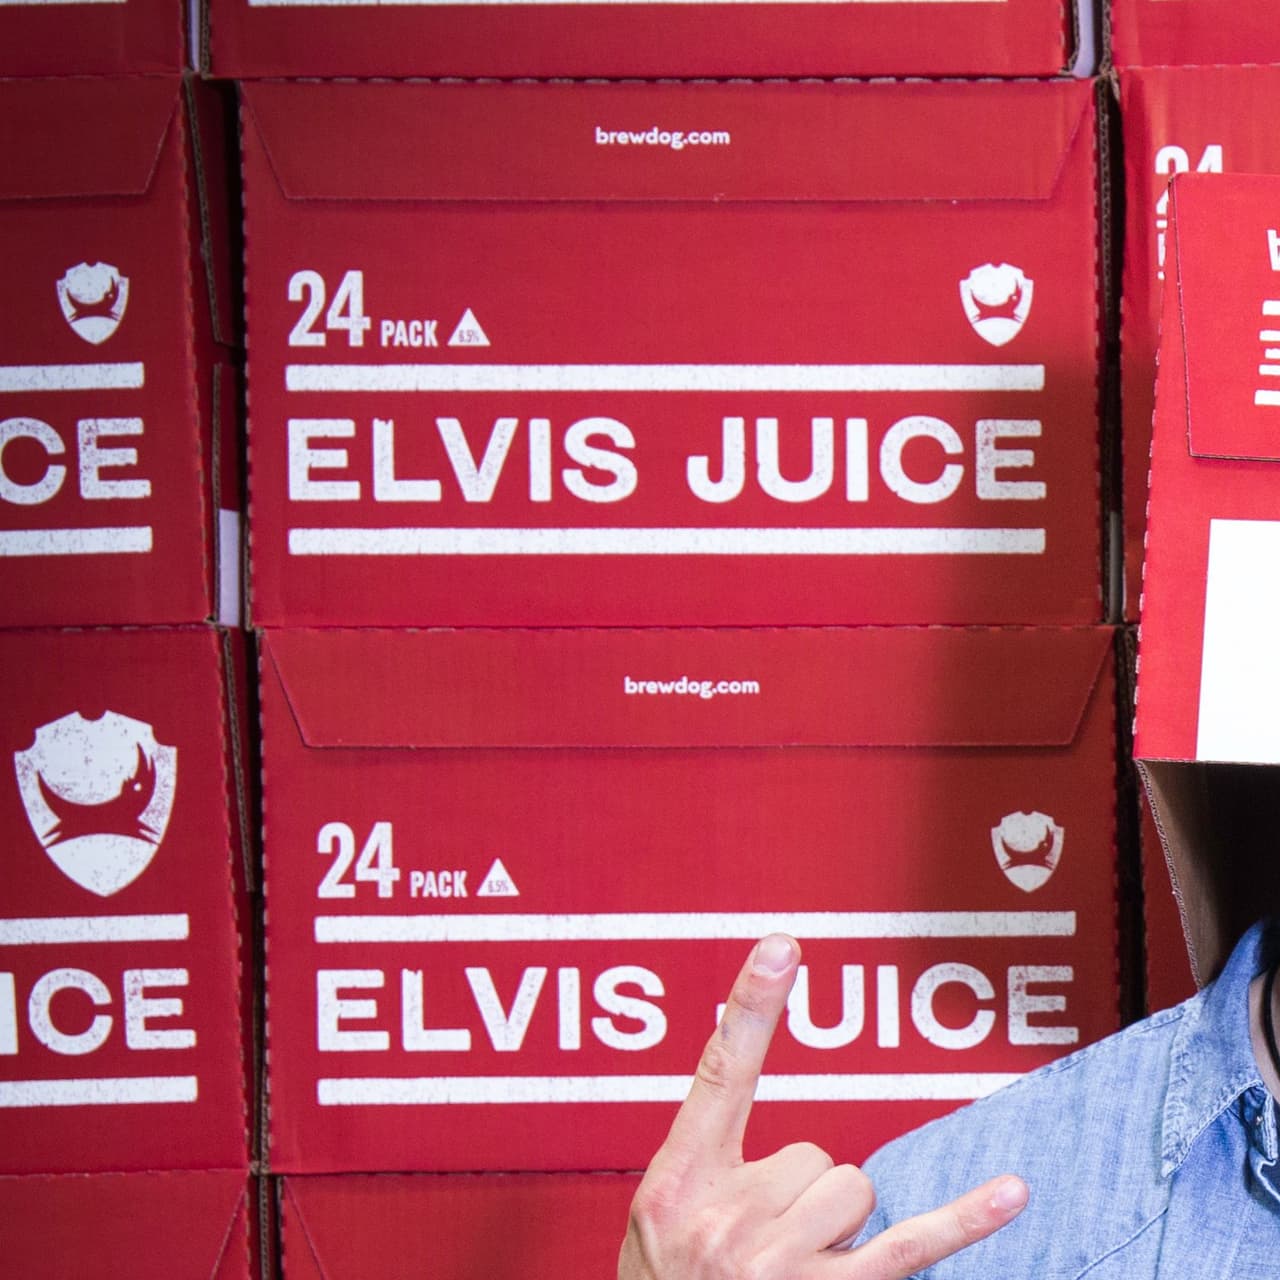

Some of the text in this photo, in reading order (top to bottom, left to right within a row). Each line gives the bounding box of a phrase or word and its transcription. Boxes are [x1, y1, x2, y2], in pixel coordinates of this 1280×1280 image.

[596, 127, 730, 149] brewdog.com
[289, 271, 371, 346] 24
[382, 320, 438, 347] PACK
[288, 416, 1046, 503] ELVIS JUICE
[625, 676, 759, 699] brewdog.com
[318, 822, 400, 898] 24
[411, 871, 467, 897] PACK
[317, 962, 1079, 1051] ELVIS UICE
